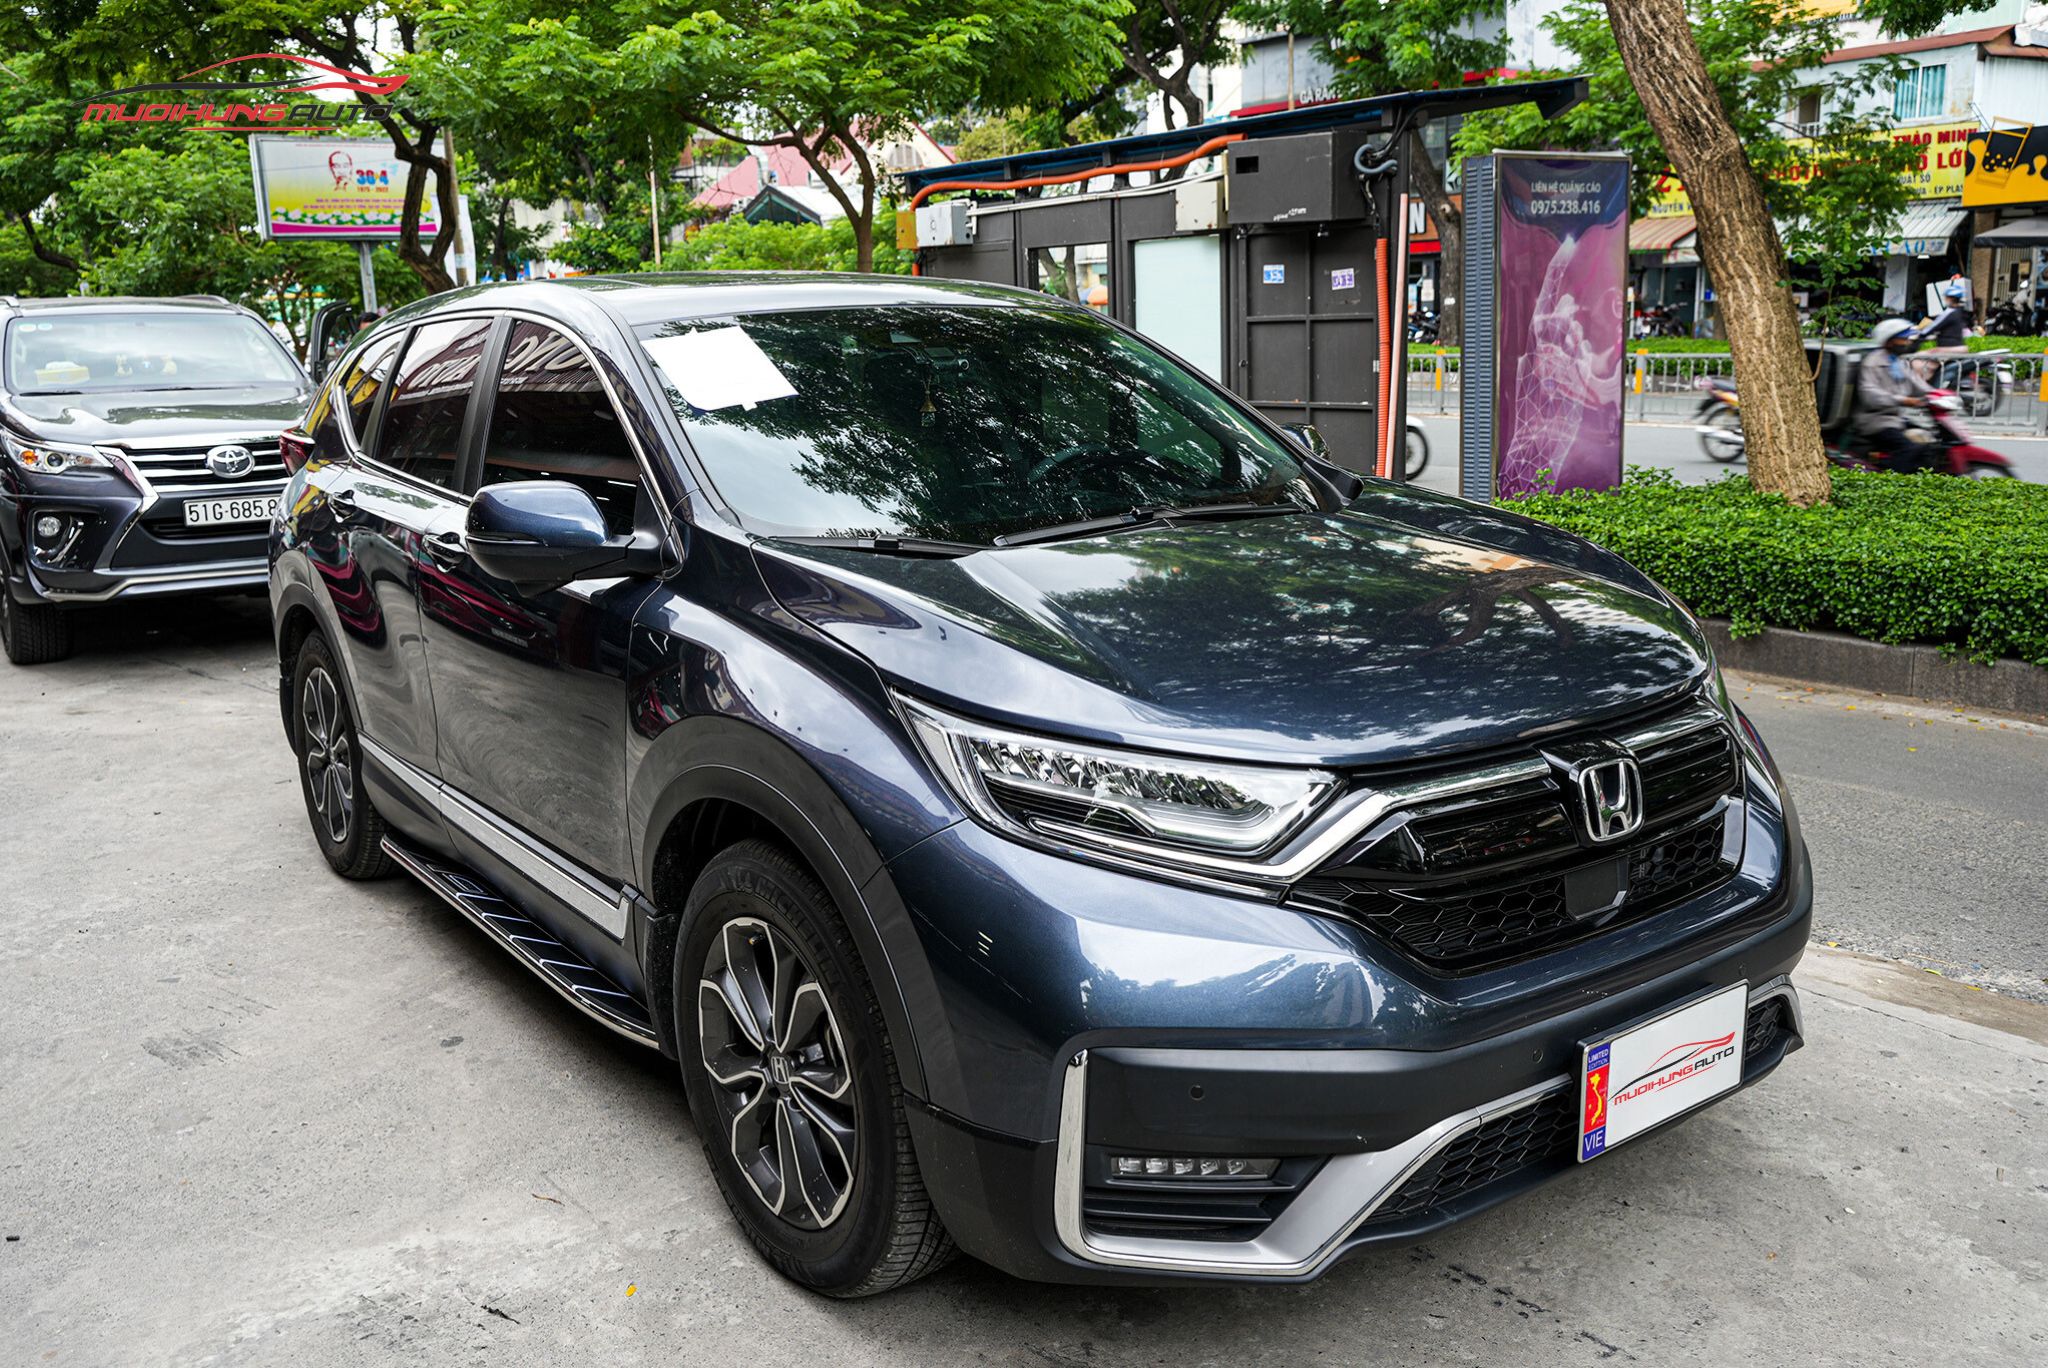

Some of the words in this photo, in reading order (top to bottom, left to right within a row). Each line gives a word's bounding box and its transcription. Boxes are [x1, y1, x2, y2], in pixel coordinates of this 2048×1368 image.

[1937, 148, 1967, 169] LỚ
[1531, 200, 1601, 215] 0975.238.416
[1584, 1130, 1604, 1152] VIE
